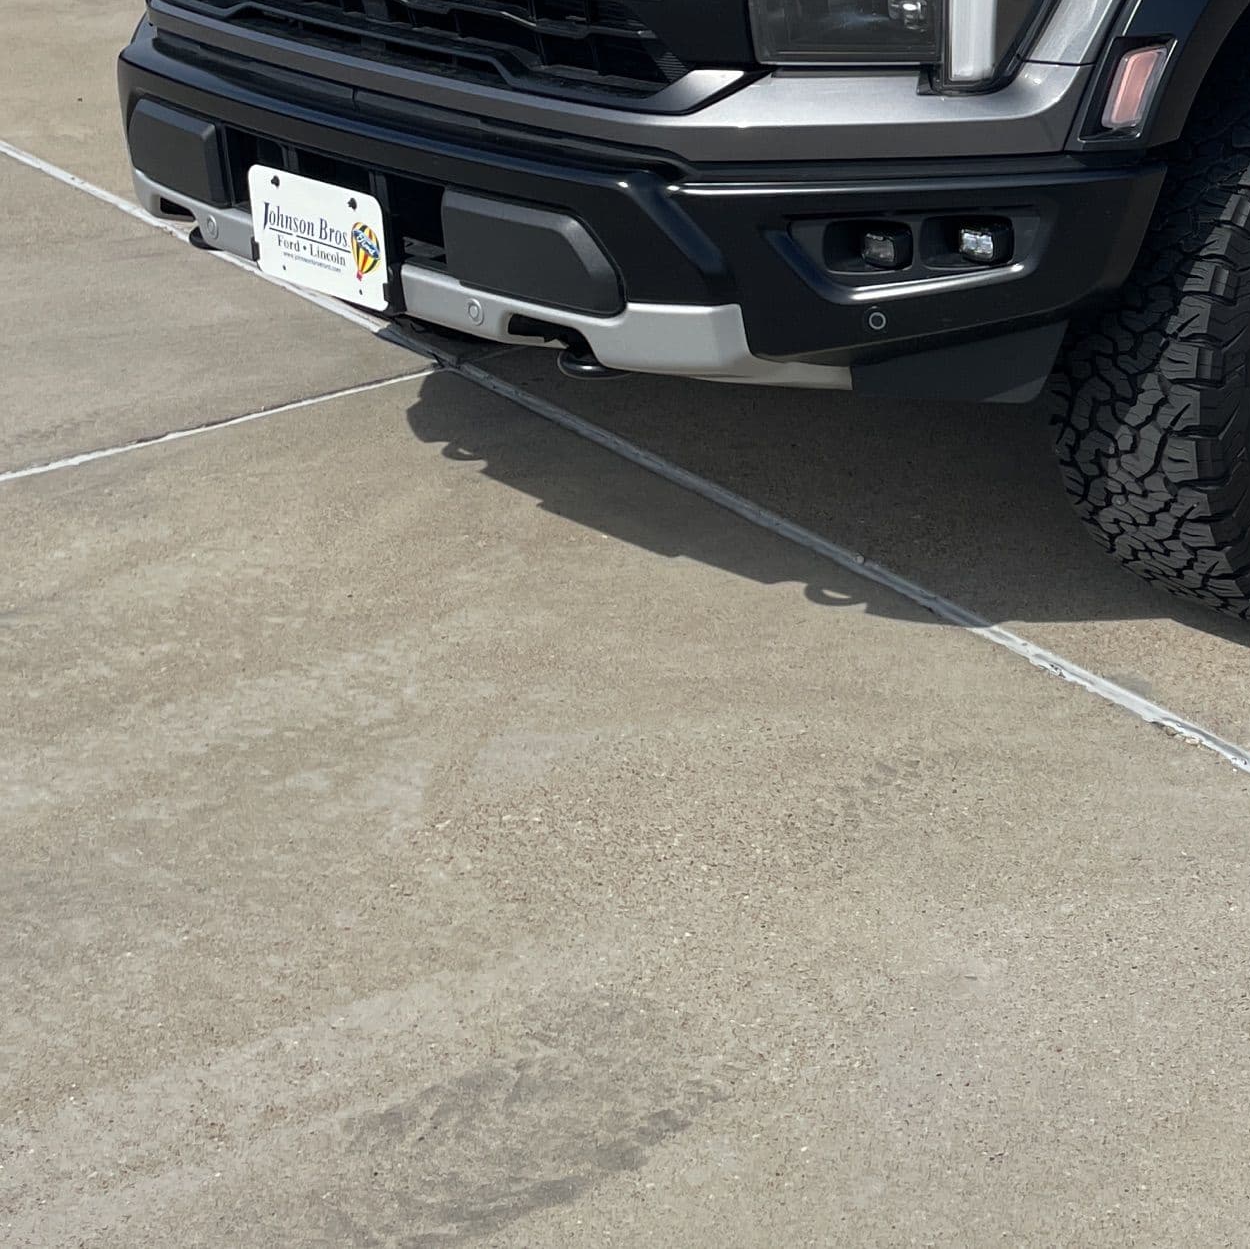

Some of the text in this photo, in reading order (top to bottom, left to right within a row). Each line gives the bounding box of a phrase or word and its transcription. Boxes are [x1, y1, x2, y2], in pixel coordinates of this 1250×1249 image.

[263, 202, 314, 237] Johnson
[277, 234, 300, 252] Ford
[309, 243, 346, 266] Lincoln
